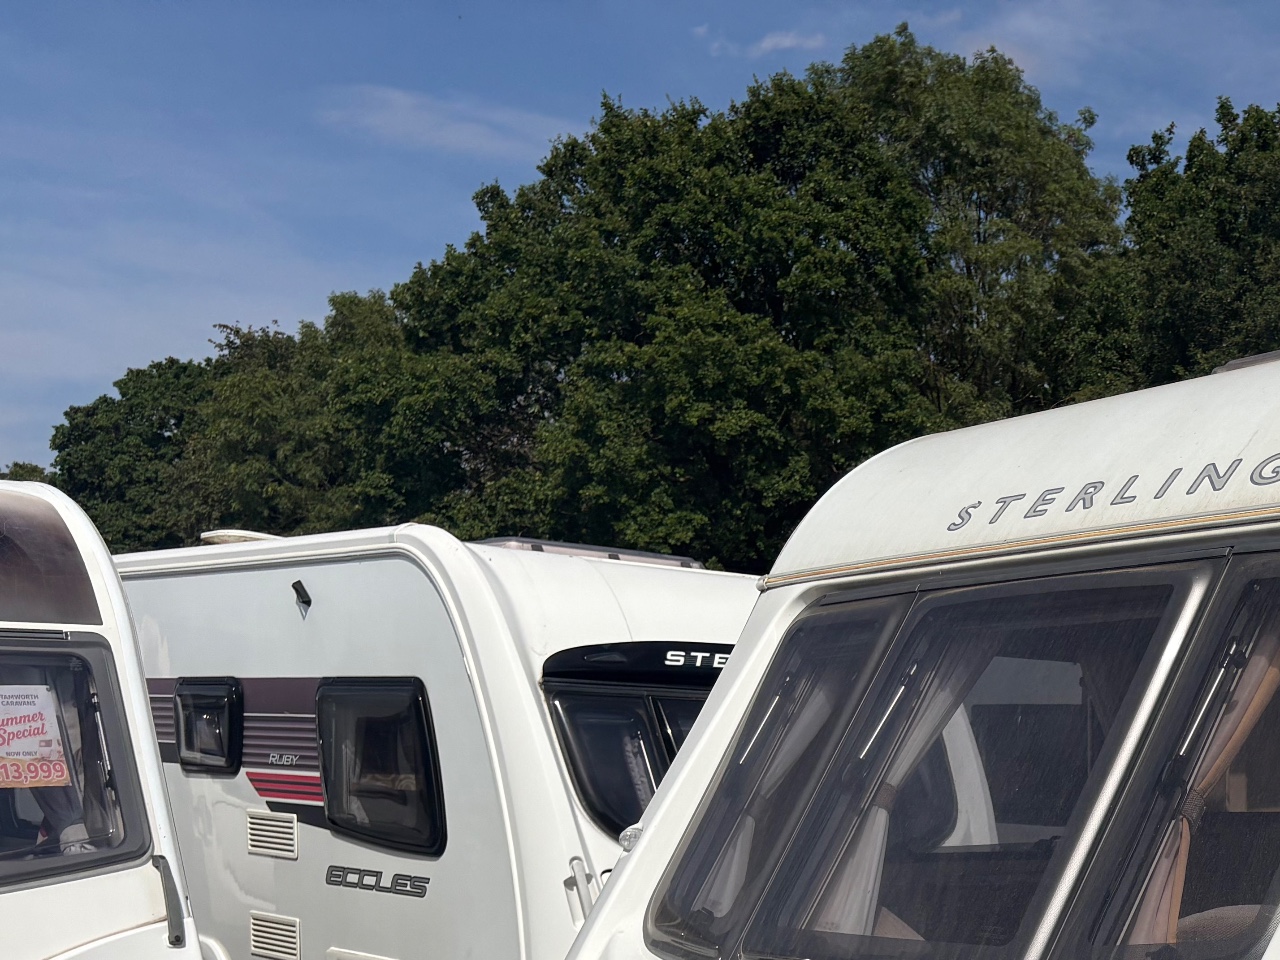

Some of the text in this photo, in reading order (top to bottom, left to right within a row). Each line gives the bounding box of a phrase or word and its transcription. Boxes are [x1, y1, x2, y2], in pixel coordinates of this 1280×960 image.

[0, 711, 45, 727] ummer
[268, 753, 300, 766] RUBY
[0, 762, 66, 784] 13,999
[326, 865, 430, 898] ECCLES
